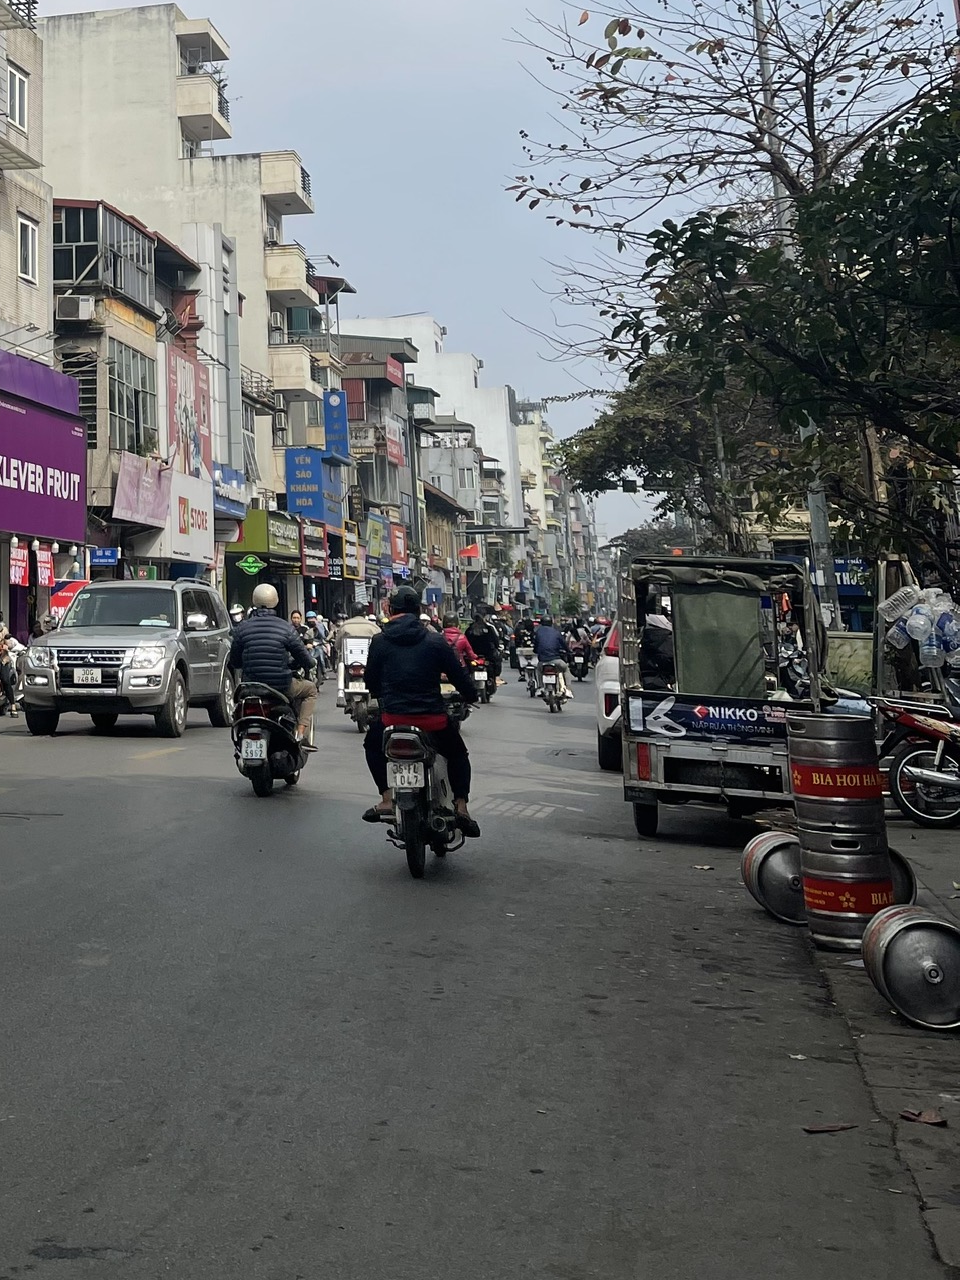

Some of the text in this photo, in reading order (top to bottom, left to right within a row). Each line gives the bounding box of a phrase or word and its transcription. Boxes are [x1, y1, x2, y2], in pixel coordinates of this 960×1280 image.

[294, 454, 311, 465] YẾN
[46, 466, 81, 502] FRUIT
[290, 482, 319, 492] KHÁNH
[190, 507, 208, 531] STORE
[709, 706, 758, 721] NIKKO
[812, 772, 834, 786] BIA
[871, 892, 889, 905] BIA
